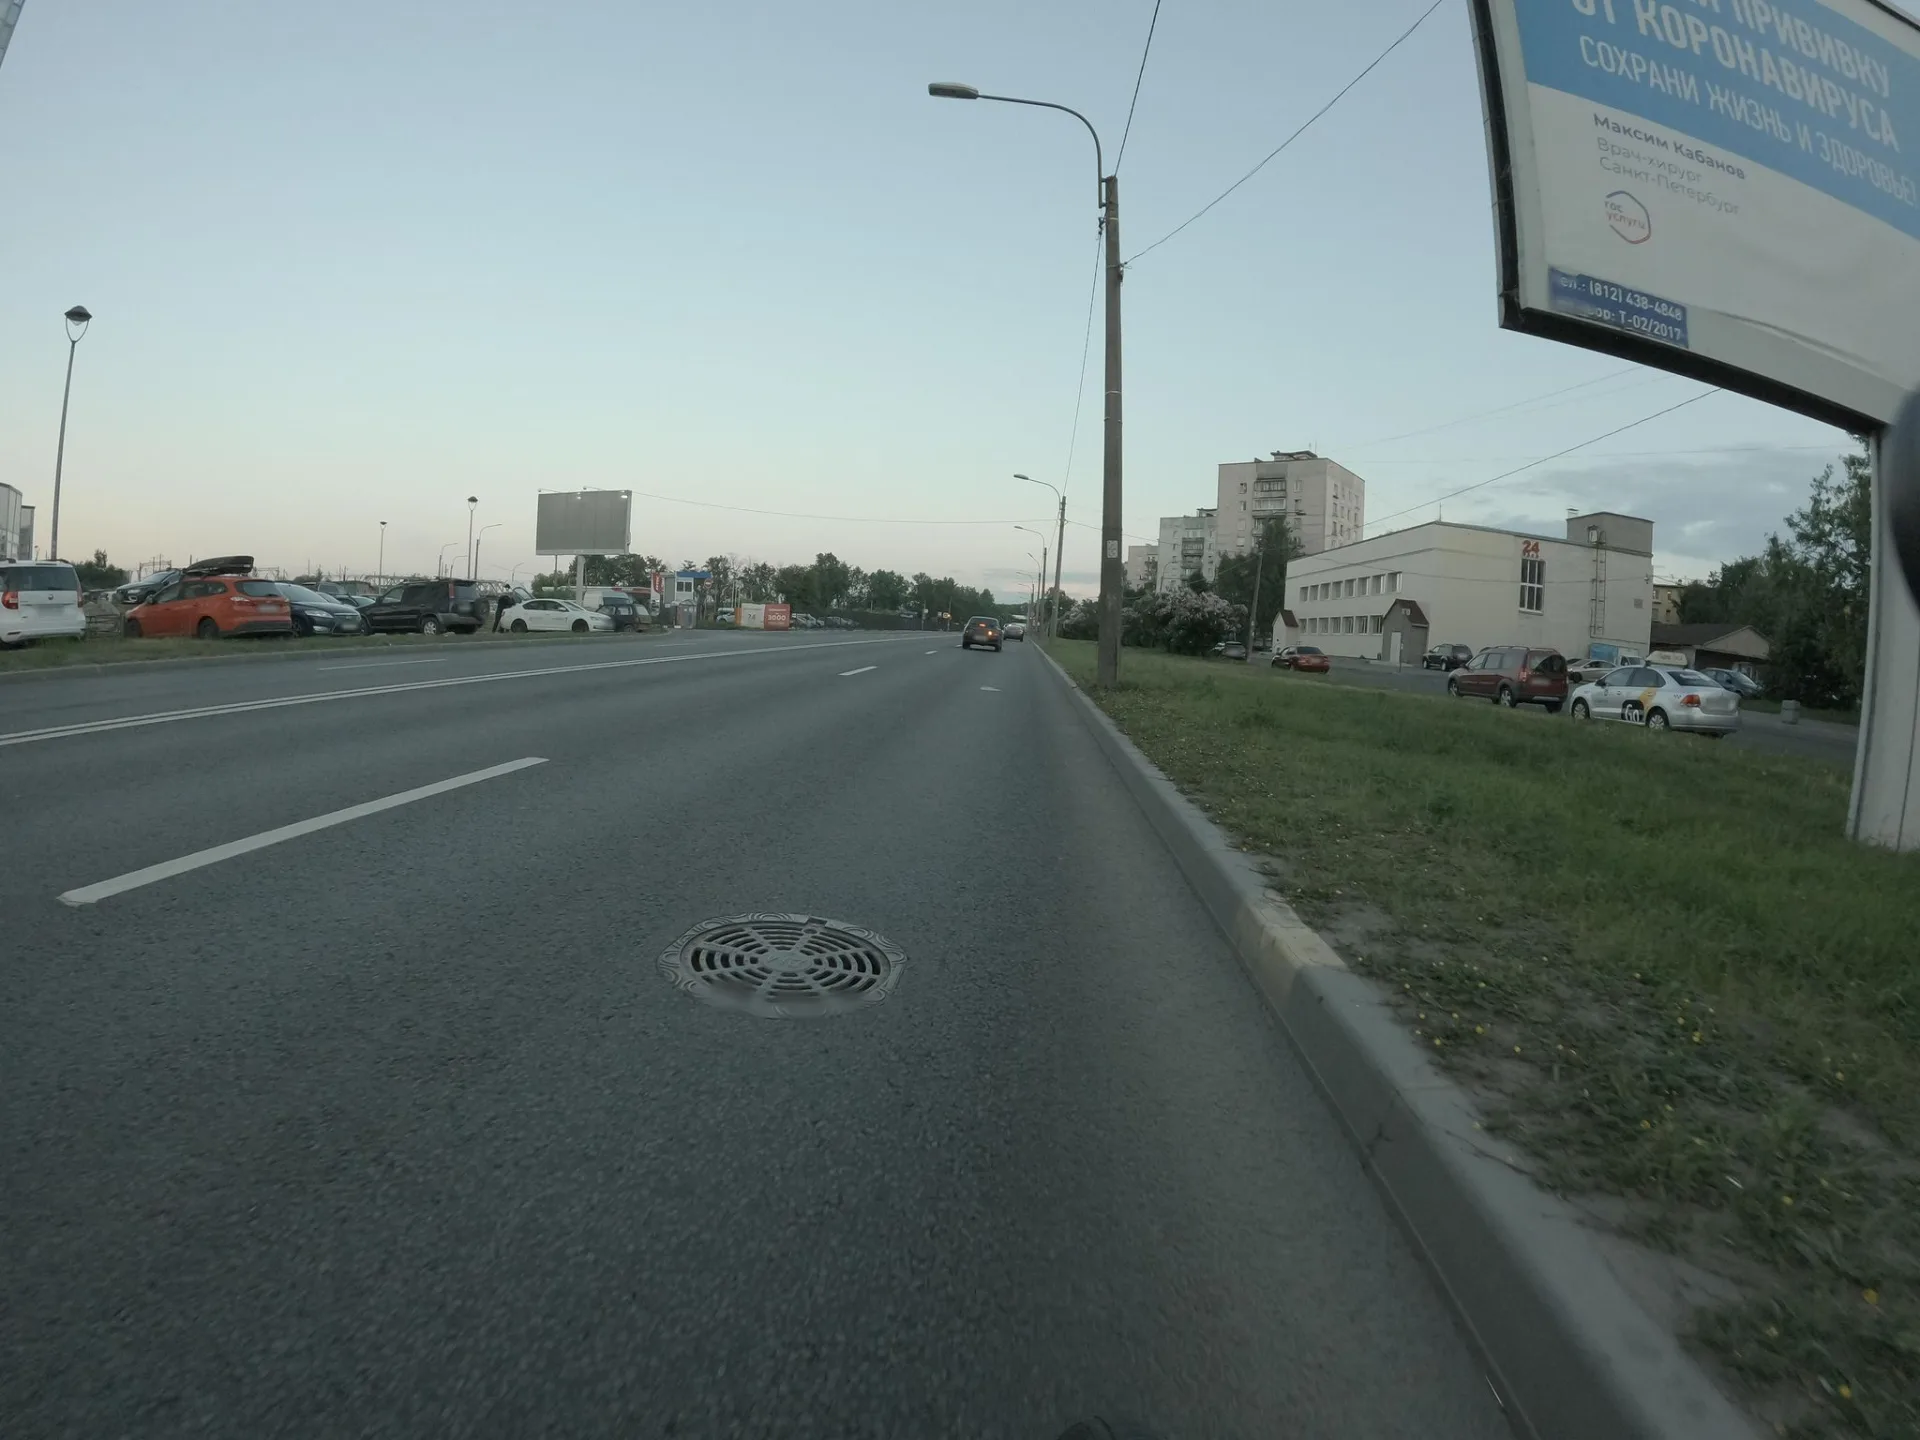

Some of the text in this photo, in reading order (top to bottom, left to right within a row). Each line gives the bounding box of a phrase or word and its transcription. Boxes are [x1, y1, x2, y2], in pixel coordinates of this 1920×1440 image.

[1633, 0, 1901, 153] КОРОНАВИРУСА
[1732, 0, 1890, 98] ПРИВИВКУ
[1579, 34, 1700, 105] СОХРАНИ
[1704, 79, 1792, 143] ЖИЗНЬ
[1796, 120, 1814, 154] И
[1593, 112, 1746, 180] Максим Кабанов
[1597, 136, 1702, 183] Врач-хирург
[1600, 156, 1740, 216] Санкт-Петербург
[1589, 279, 1622, 303] (812)
[1619, 309, 1681, 341] Т-02/2017
